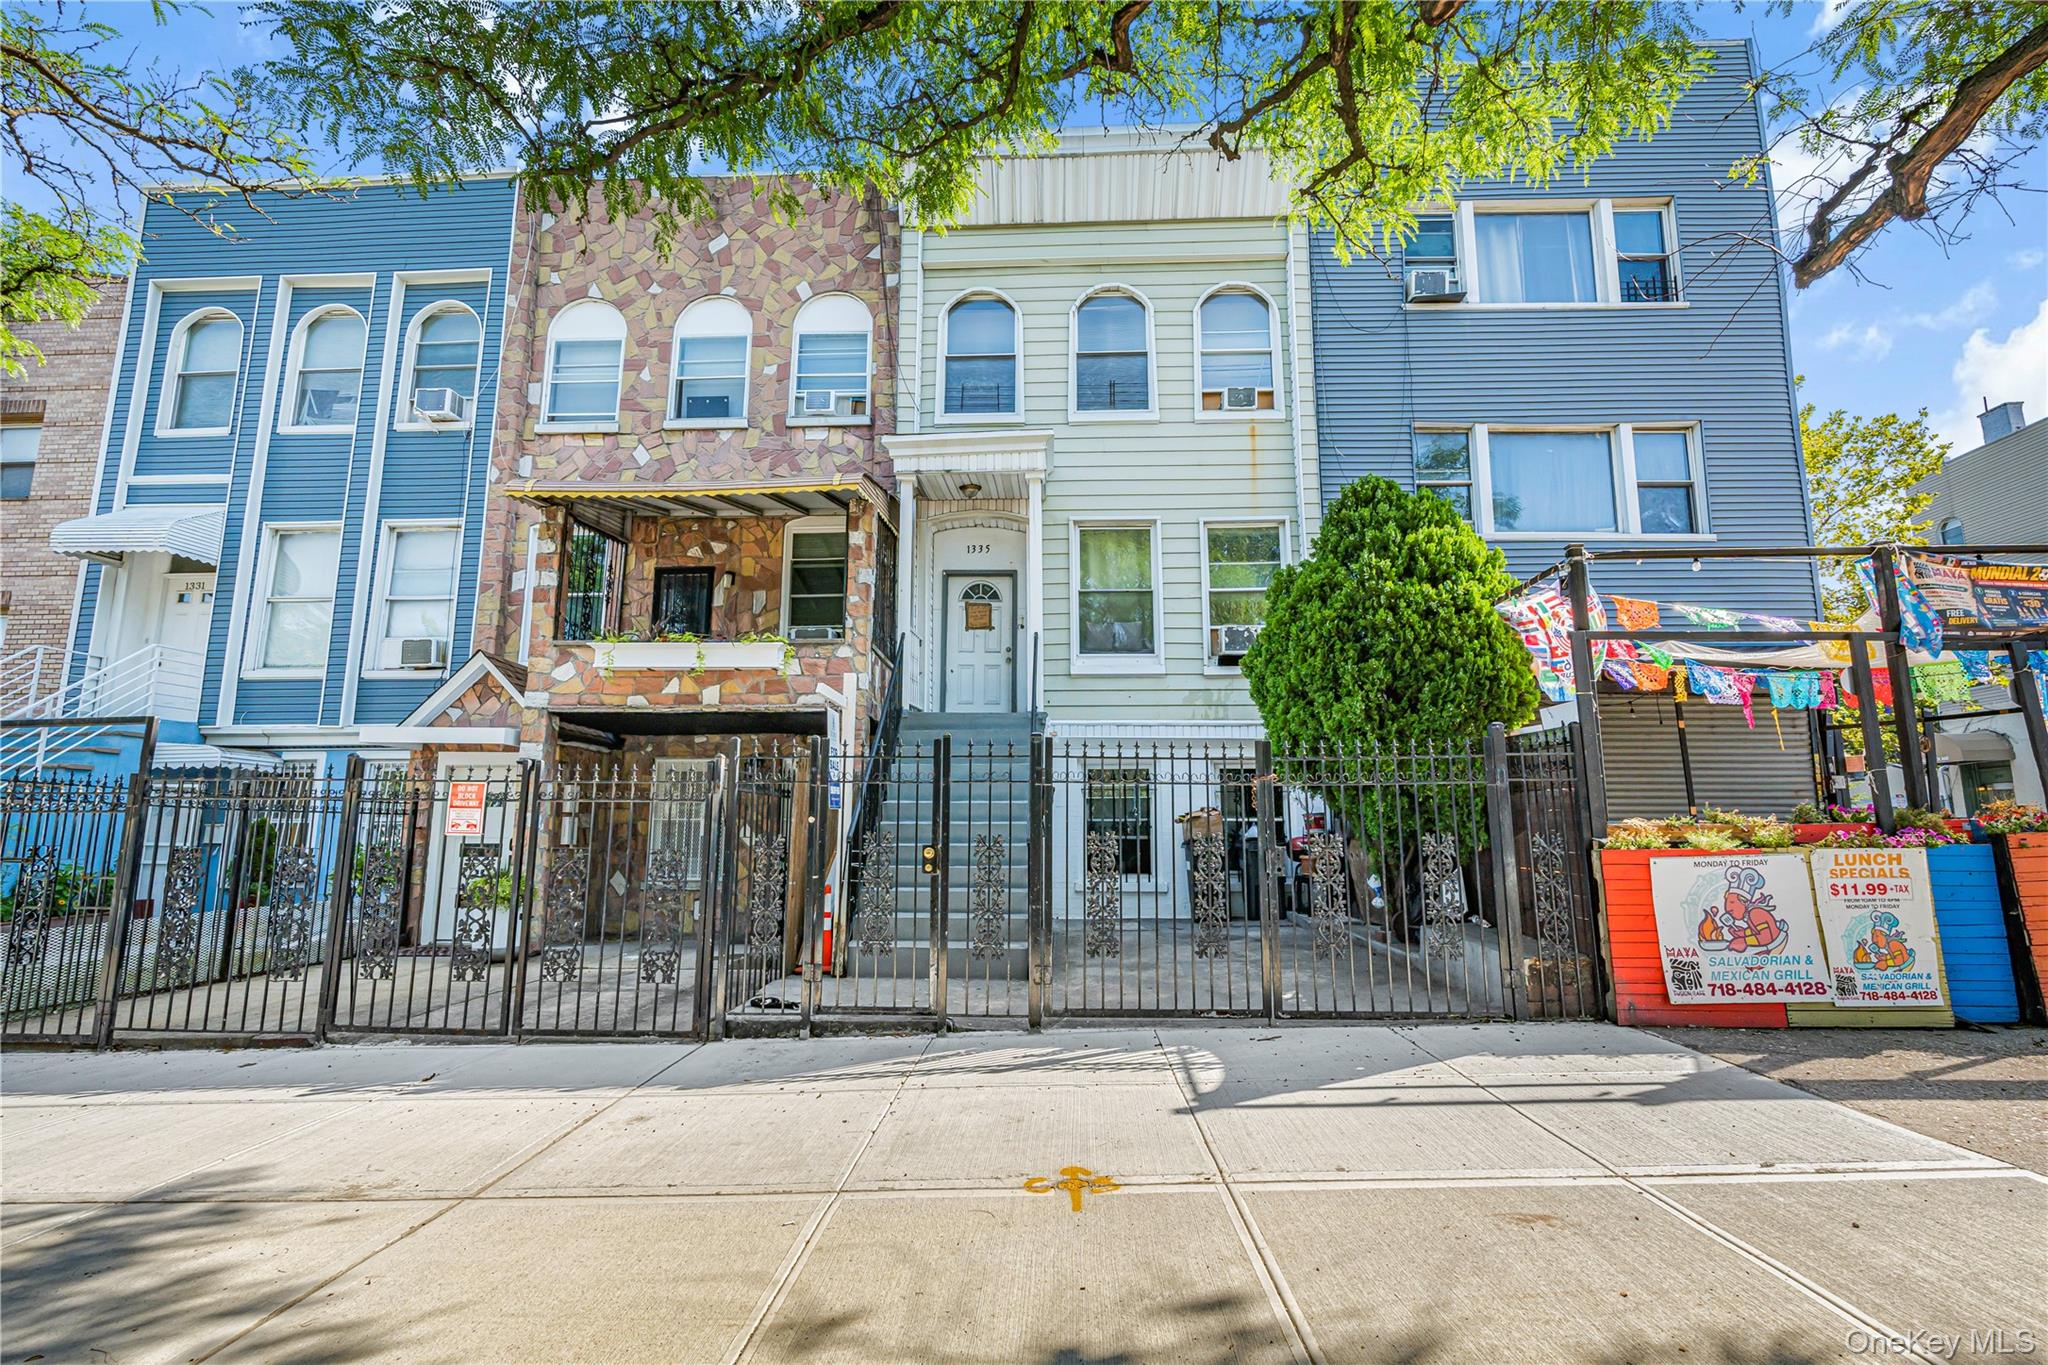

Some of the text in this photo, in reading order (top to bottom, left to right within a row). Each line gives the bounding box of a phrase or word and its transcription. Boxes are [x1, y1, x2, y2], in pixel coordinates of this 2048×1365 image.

[966, 544, 991, 554] 1335
[1970, 565, 2030, 581] MUNDIAL
[184, 581, 206, 591] 1331
[1983, 597, 2009, 605] GRATIS
[1946, 609, 1965, 617] FREE
[1948, 616, 1978, 625] DELIVERY
[830, 746, 838, 756] FOR
[829, 759, 840, 771] SALE
[1693, 860, 1728, 868] MONDAY
[1742, 859, 1769, 867] FRIDAY
[1834, 853, 1903, 866] LUNCH
[1829, 867, 1911, 878] SPECIALS
[1830, 883, 1888, 897] $11.99
[1665, 947, 1700, 959] MAYA
[1708, 955, 1814, 967] SALVADORIAN &
[1711, 970, 1814, 981] MEXICAN GRILL
[1832, 966, 1855, 975] MAYA
[1925, 972, 1933, 980] &
[1707, 981, 1828, 997] 718-484-4128
[1904, 982, 1931, 991] GRILL
[1859, 990, 1938, 1001] 718-484-4128
